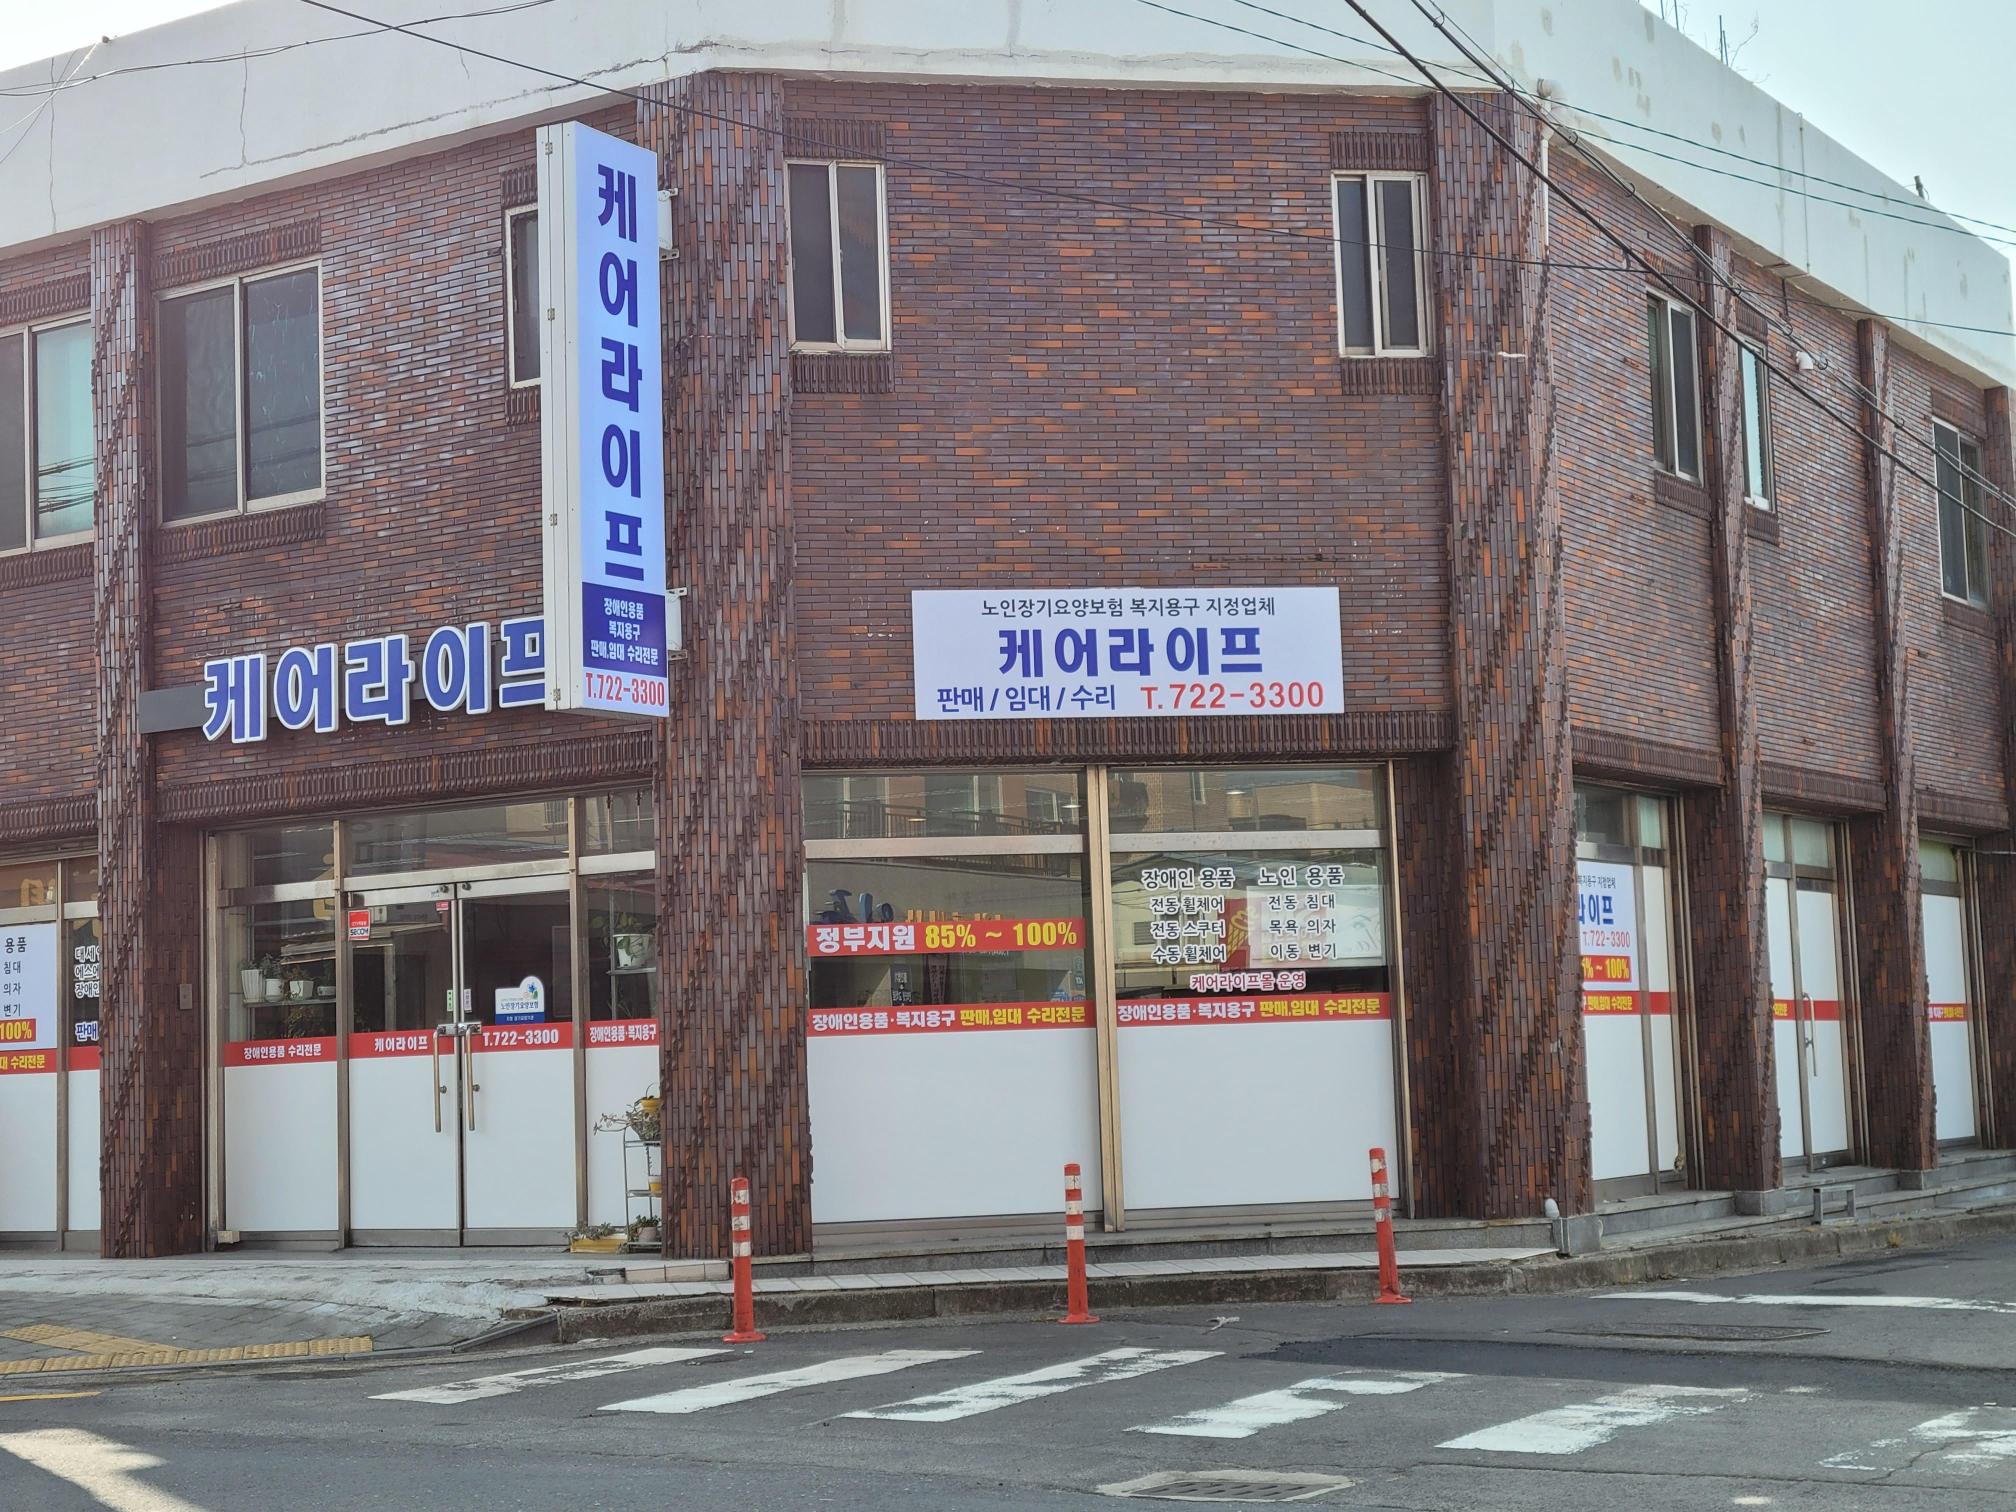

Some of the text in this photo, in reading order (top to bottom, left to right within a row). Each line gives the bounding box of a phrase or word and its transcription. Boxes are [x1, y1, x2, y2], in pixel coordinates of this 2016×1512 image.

[597, 163, 644, 582] 케어라이프
[603, 597, 644, 621] 장애인용품
[981, 597, 1275, 618] 노인장기요양보험 복지용구 지정업체
[608, 620, 641, 641] 복지용구
[627, 645, 659, 666] 수리전문
[998, 627, 1263, 678] 케어라이프
[201, 615, 545, 743] 케어라이프
[585, 672, 665, 707] T.722-3300
[1142, 868, 1235, 890] 장애인 용품
[1259, 866, 1344, 887] 노인 용품
[1151, 896, 1224, 914] 전동 휠체어
[1268, 893, 1335, 910] 전동 침대
[1152, 920, 1225, 939] 전동 스쿠터
[1269, 918, 1336, 935] 목욕 의자
[4, 936, 28, 955] 용품
[815, 925, 915, 953] 정부지원
[925, 924, 976, 949] 85%
[1012, 921, 1077, 946] 100%
[1152, 944, 1226, 963] 수동 휠체어
[1270, 943, 1337, 960] 이동 변기
[3, 960, 21, 975] 침대
[1605, 958, 1630, 979] 100%
[3, 982, 21, 997] 의자
[1190, 971, 1307, 992] 케어라이프몰 운영
[3, 1003, 21, 1018] 변기
[1027, 1006, 1086, 1024] 수리전문
[1324, 998, 1380, 1016] 수리전문
[374, 1035, 428, 1052] 케어라이프
[482, 1028, 560, 1047] T.722-3300
[243, 1043, 322, 1060] 장애인용품 수리전문
[10, 1054, 46, 1070] 수리전문
